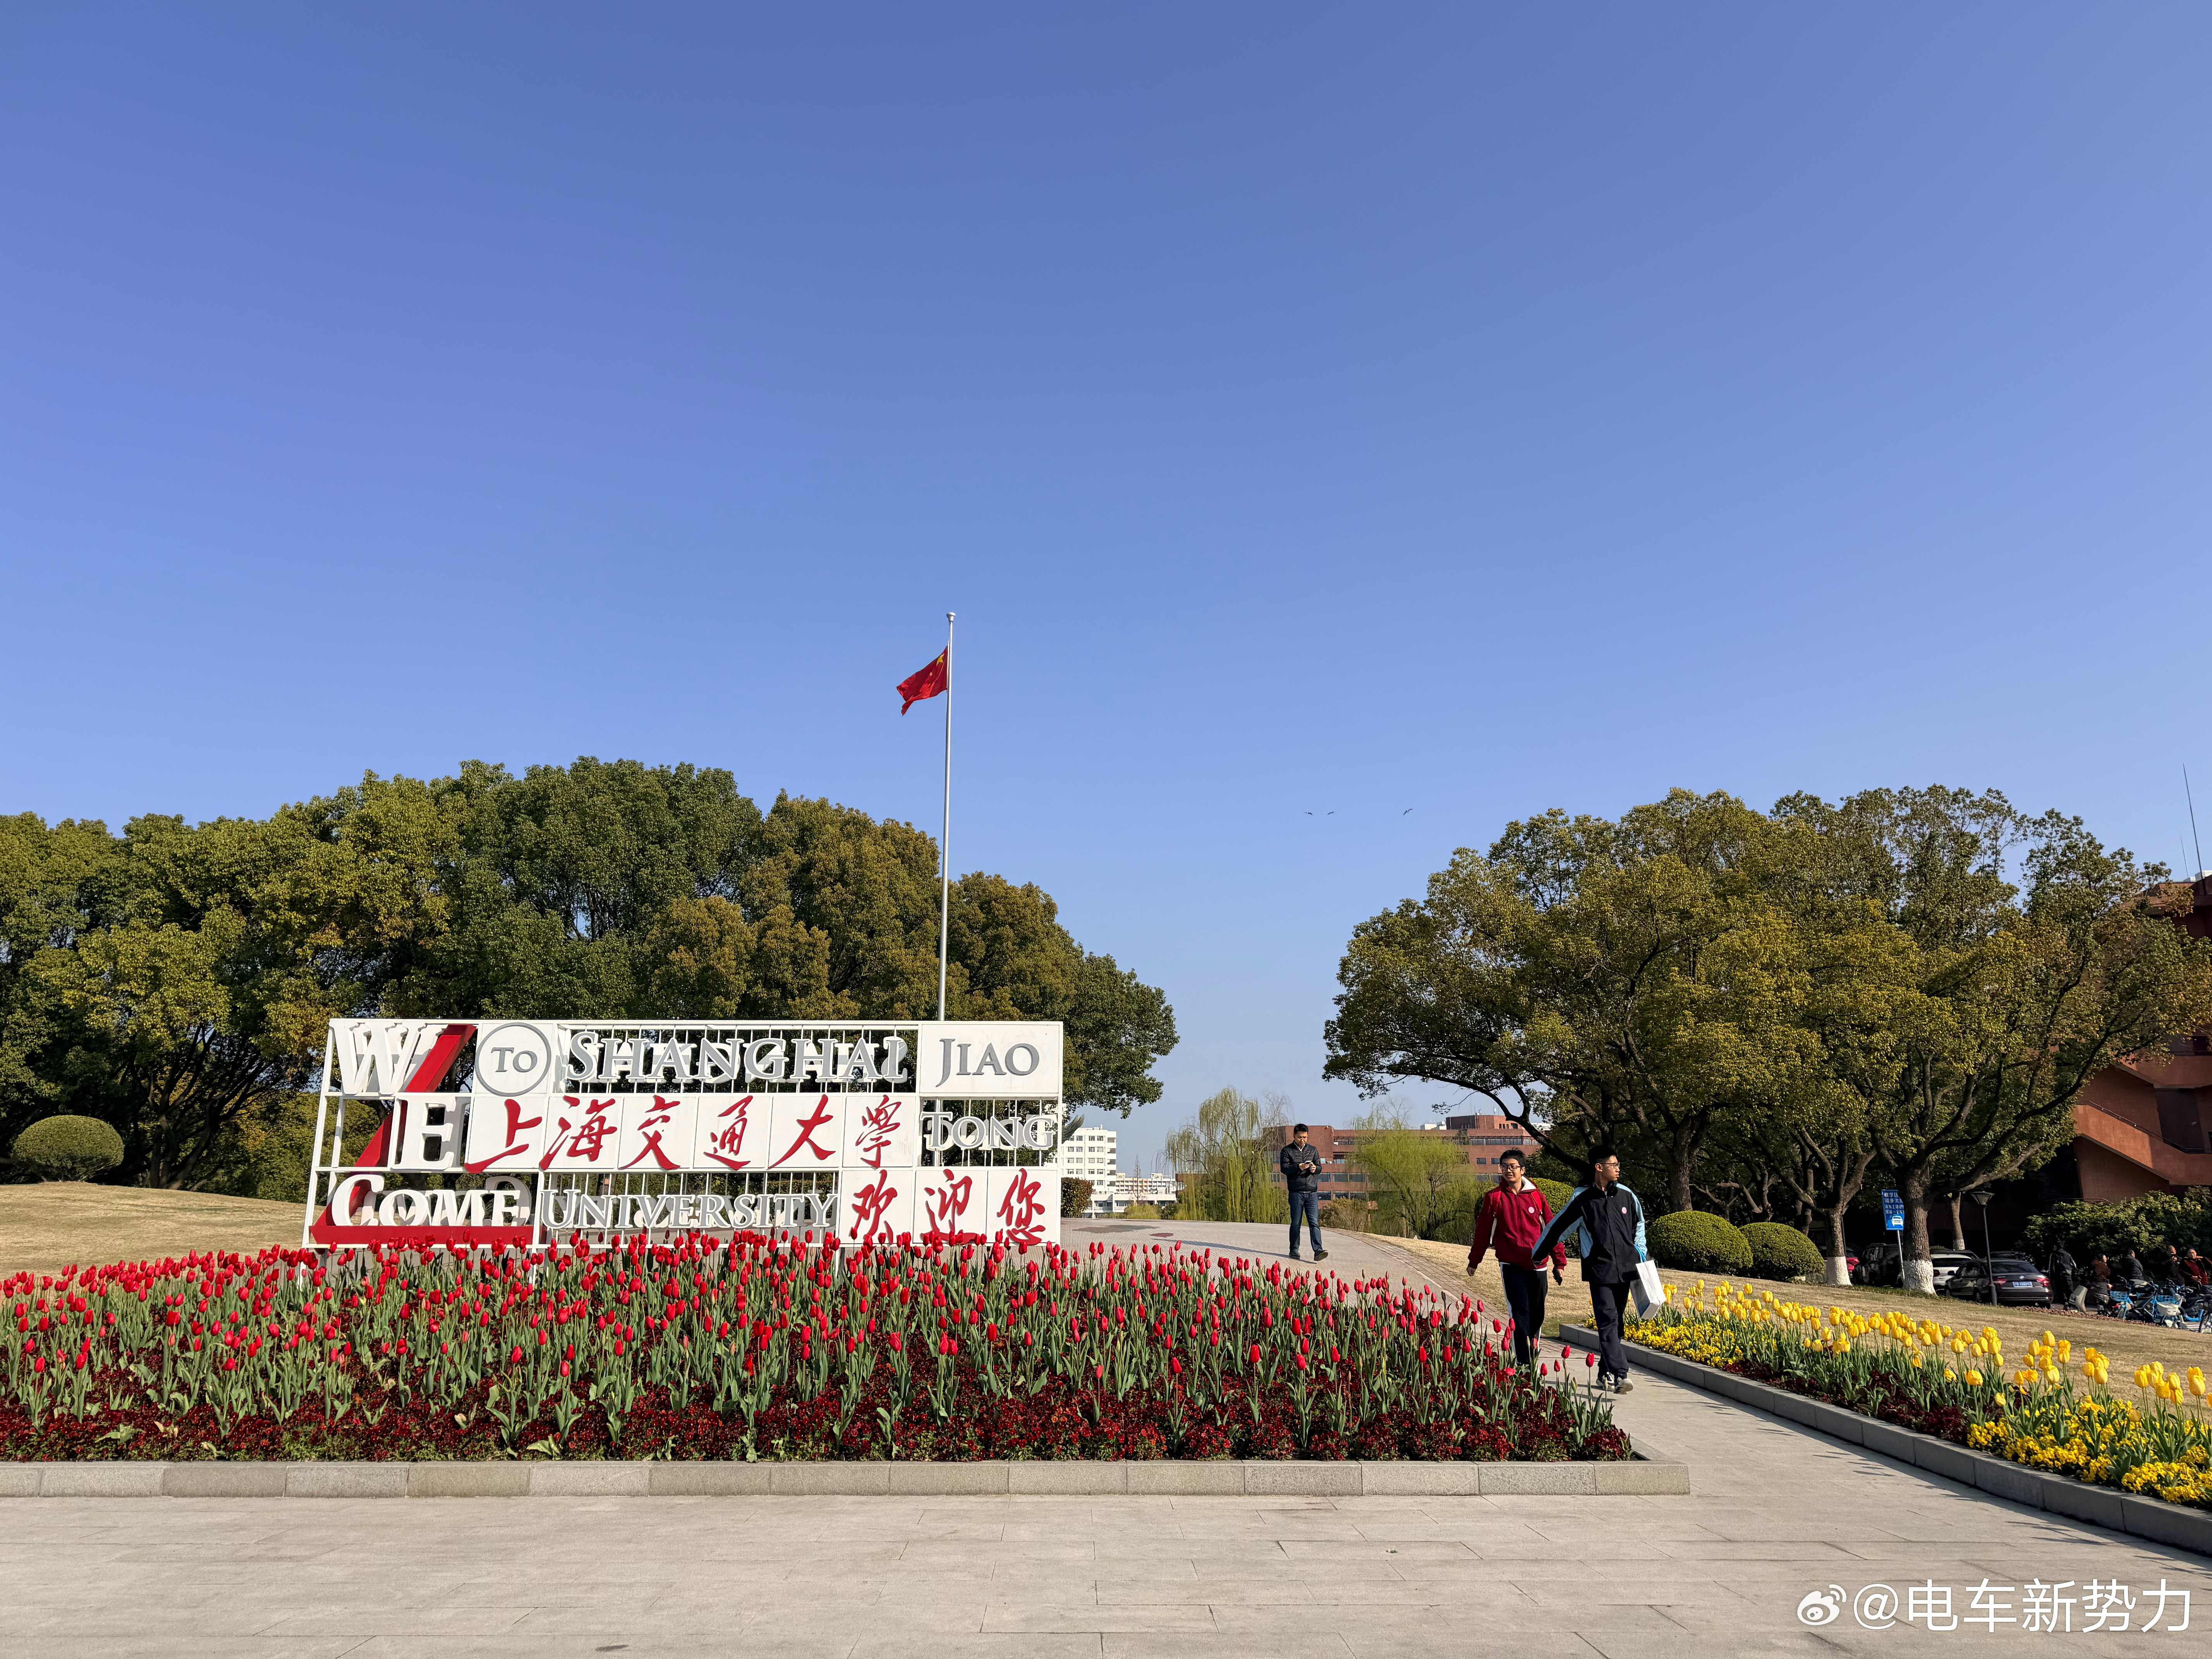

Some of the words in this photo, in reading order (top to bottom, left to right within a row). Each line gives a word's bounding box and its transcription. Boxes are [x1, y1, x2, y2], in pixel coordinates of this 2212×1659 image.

[566, 1031, 907, 1080] SHANGHAI
[936, 1038, 1040, 1088] JIAO
[920, 1111, 1056, 1150] TONG
[540, 1188, 839, 1229] UNIVERSITY
[851, 1168, 1046, 1245] 欢迎您
